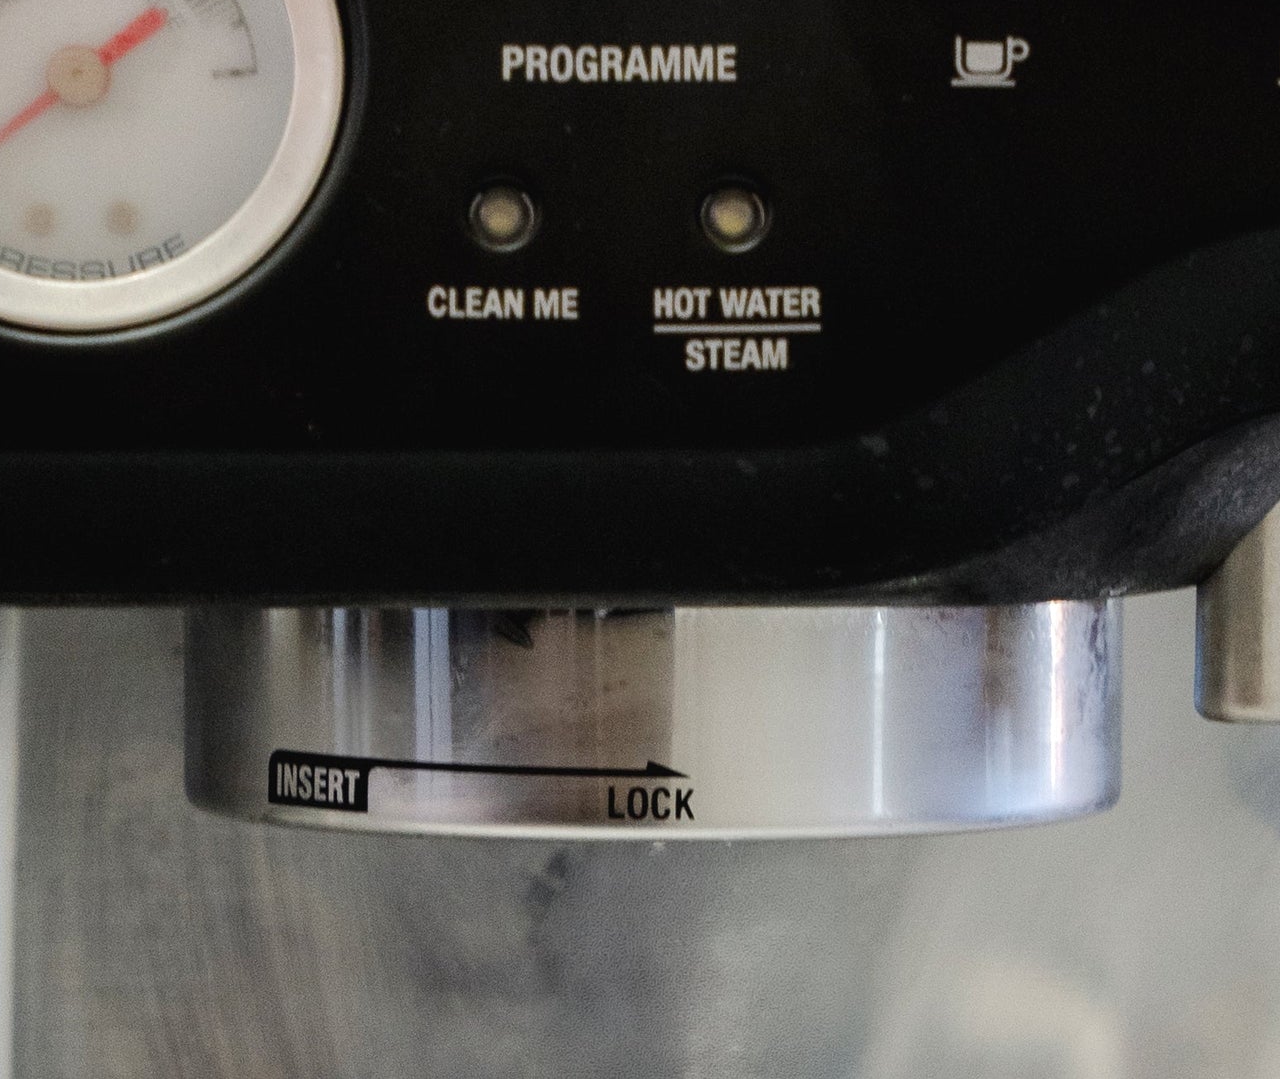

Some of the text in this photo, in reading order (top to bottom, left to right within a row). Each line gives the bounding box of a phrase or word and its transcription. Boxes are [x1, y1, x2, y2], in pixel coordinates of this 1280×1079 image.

[501, 44, 737, 83] PROGRAMME
[427, 285, 579, 319] CLEAN ME
[653, 286, 821, 319] HOT WATER
[685, 338, 788, 371] STEAM
[276, 762, 360, 805] INSERT
[607, 786, 695, 820] LOCK
